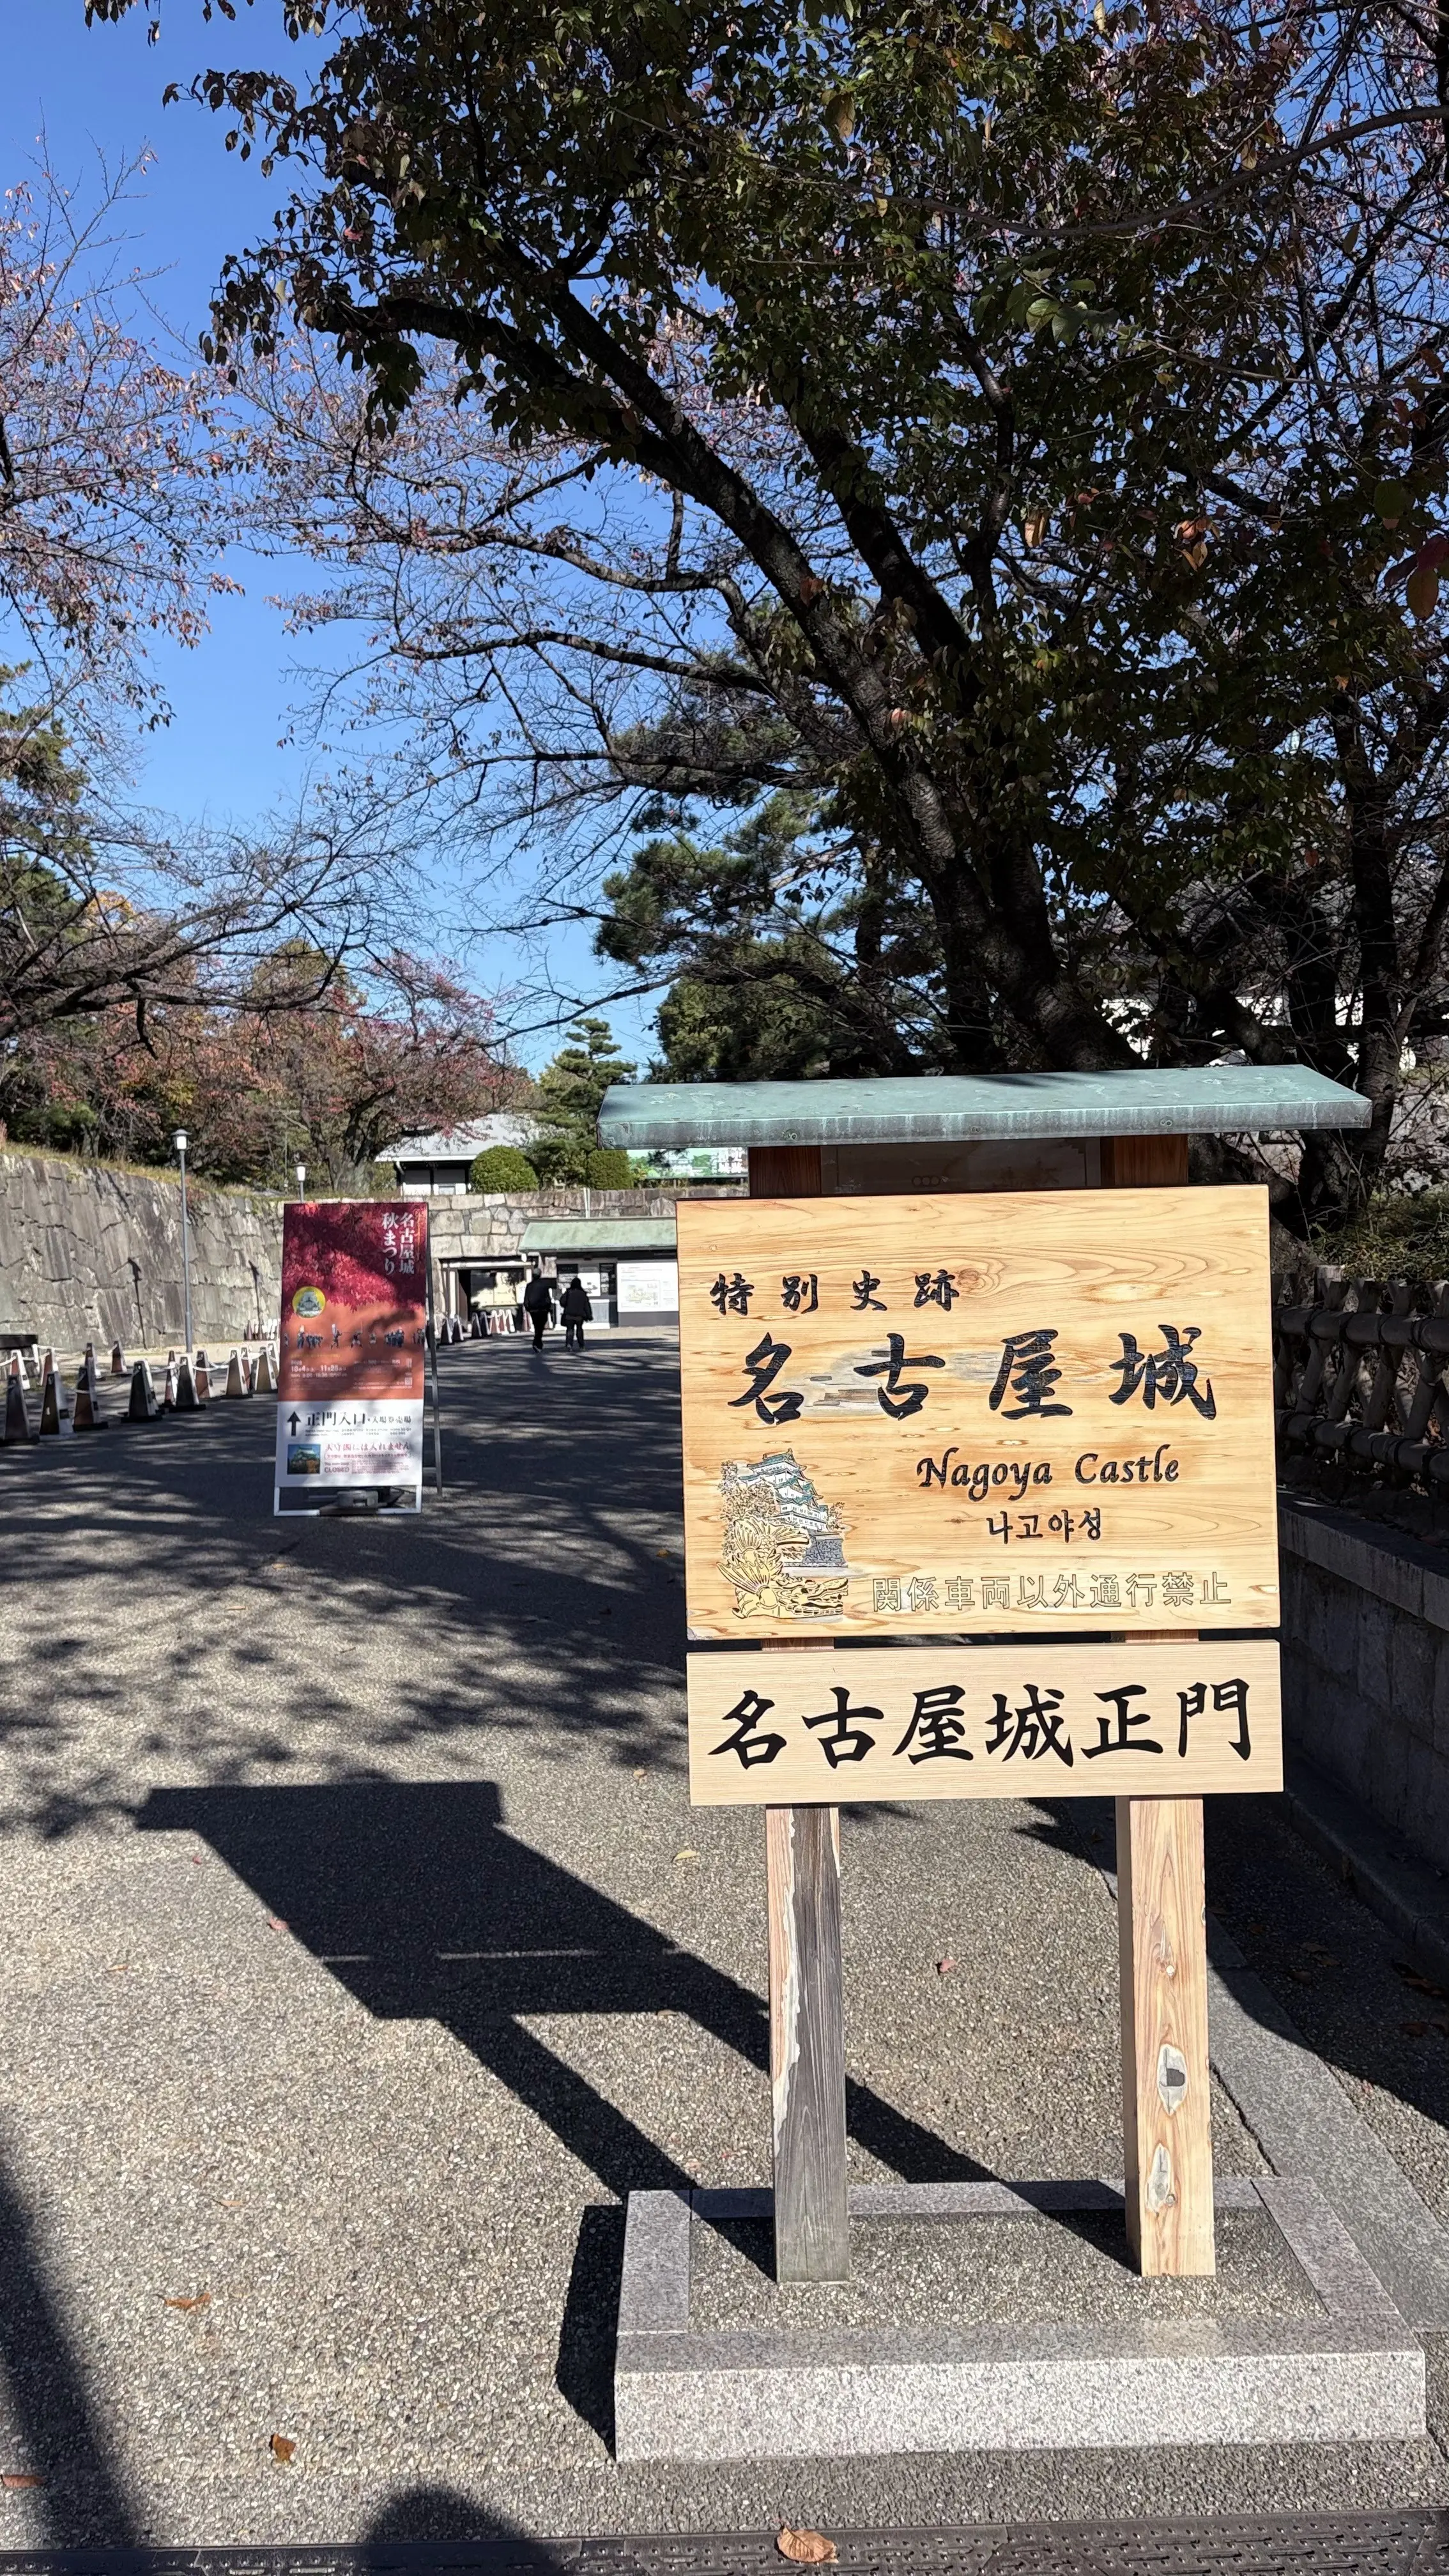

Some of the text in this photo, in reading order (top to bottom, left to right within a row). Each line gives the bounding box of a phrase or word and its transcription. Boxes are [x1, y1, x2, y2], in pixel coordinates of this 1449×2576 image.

[381, 1212, 399, 1276] 秋まつり
[399, 1212, 415, 1275] 名古屋城
[709, 1269, 960, 1316] 特別史跡
[726, 1324, 1218, 1426] 名古屋城
[916, 1444, 1180, 1503] Nagoya Castle
[985, 1506, 1103, 1544] 나고야성
[872, 1571, 1232, 1613] 関係車両以外通行禁止
[708, 1677, 1252, 1770] 名古屋城正門
